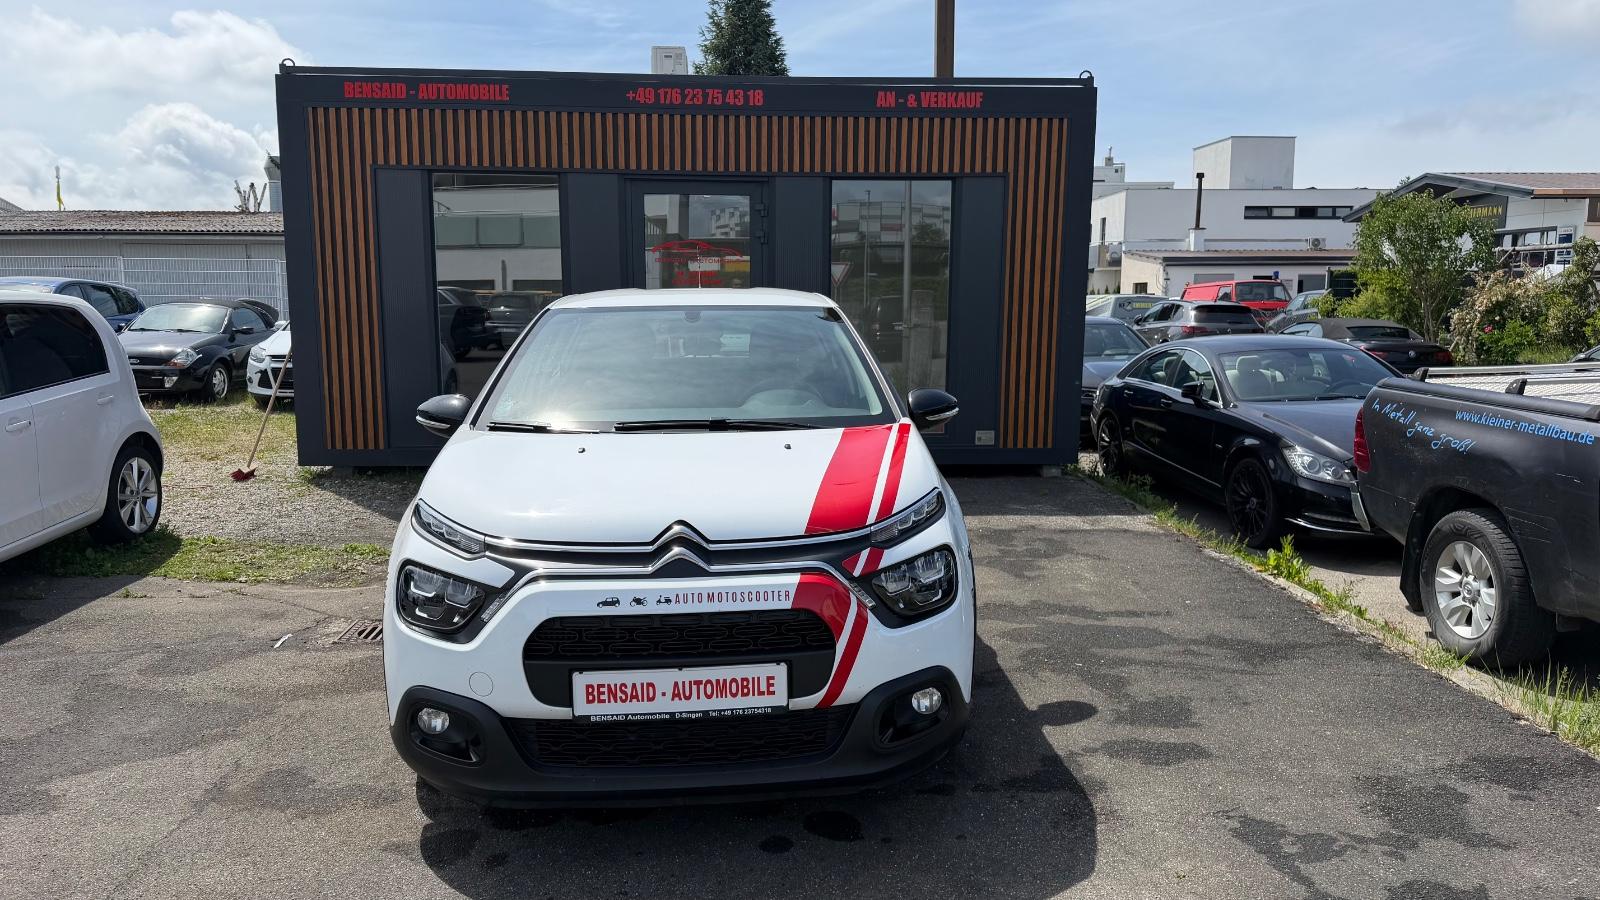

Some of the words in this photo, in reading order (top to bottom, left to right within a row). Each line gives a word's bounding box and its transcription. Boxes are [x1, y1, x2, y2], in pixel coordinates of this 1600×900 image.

[344, 82, 407, 99] BENSAID
[418, 83, 510, 100] AUTOMOBILE
[626, 87, 655, 104] +49
[657, 88, 682, 105] 176
[684, 88, 703, 105] 23
[706, 89, 723, 105] 75
[726, 89, 744, 106] 43
[747, 90, 764, 106] 18
[876, 91, 896, 108] AN
[907, 94, 918, 108] &
[920, 91, 984, 108] VERKAUF
[1381, 402, 1417, 425] Metall
[1406, 421, 1435, 438] ganz
[1455, 409, 1595, 445] www.kleiner-metallbau.de
[585, 682, 657, 705] BENSAID
[671, 675, 776, 702] AUTOMOBILE
[590, 714, 626, 722] BENSAID
[627, 712, 670, 721] Automobile
